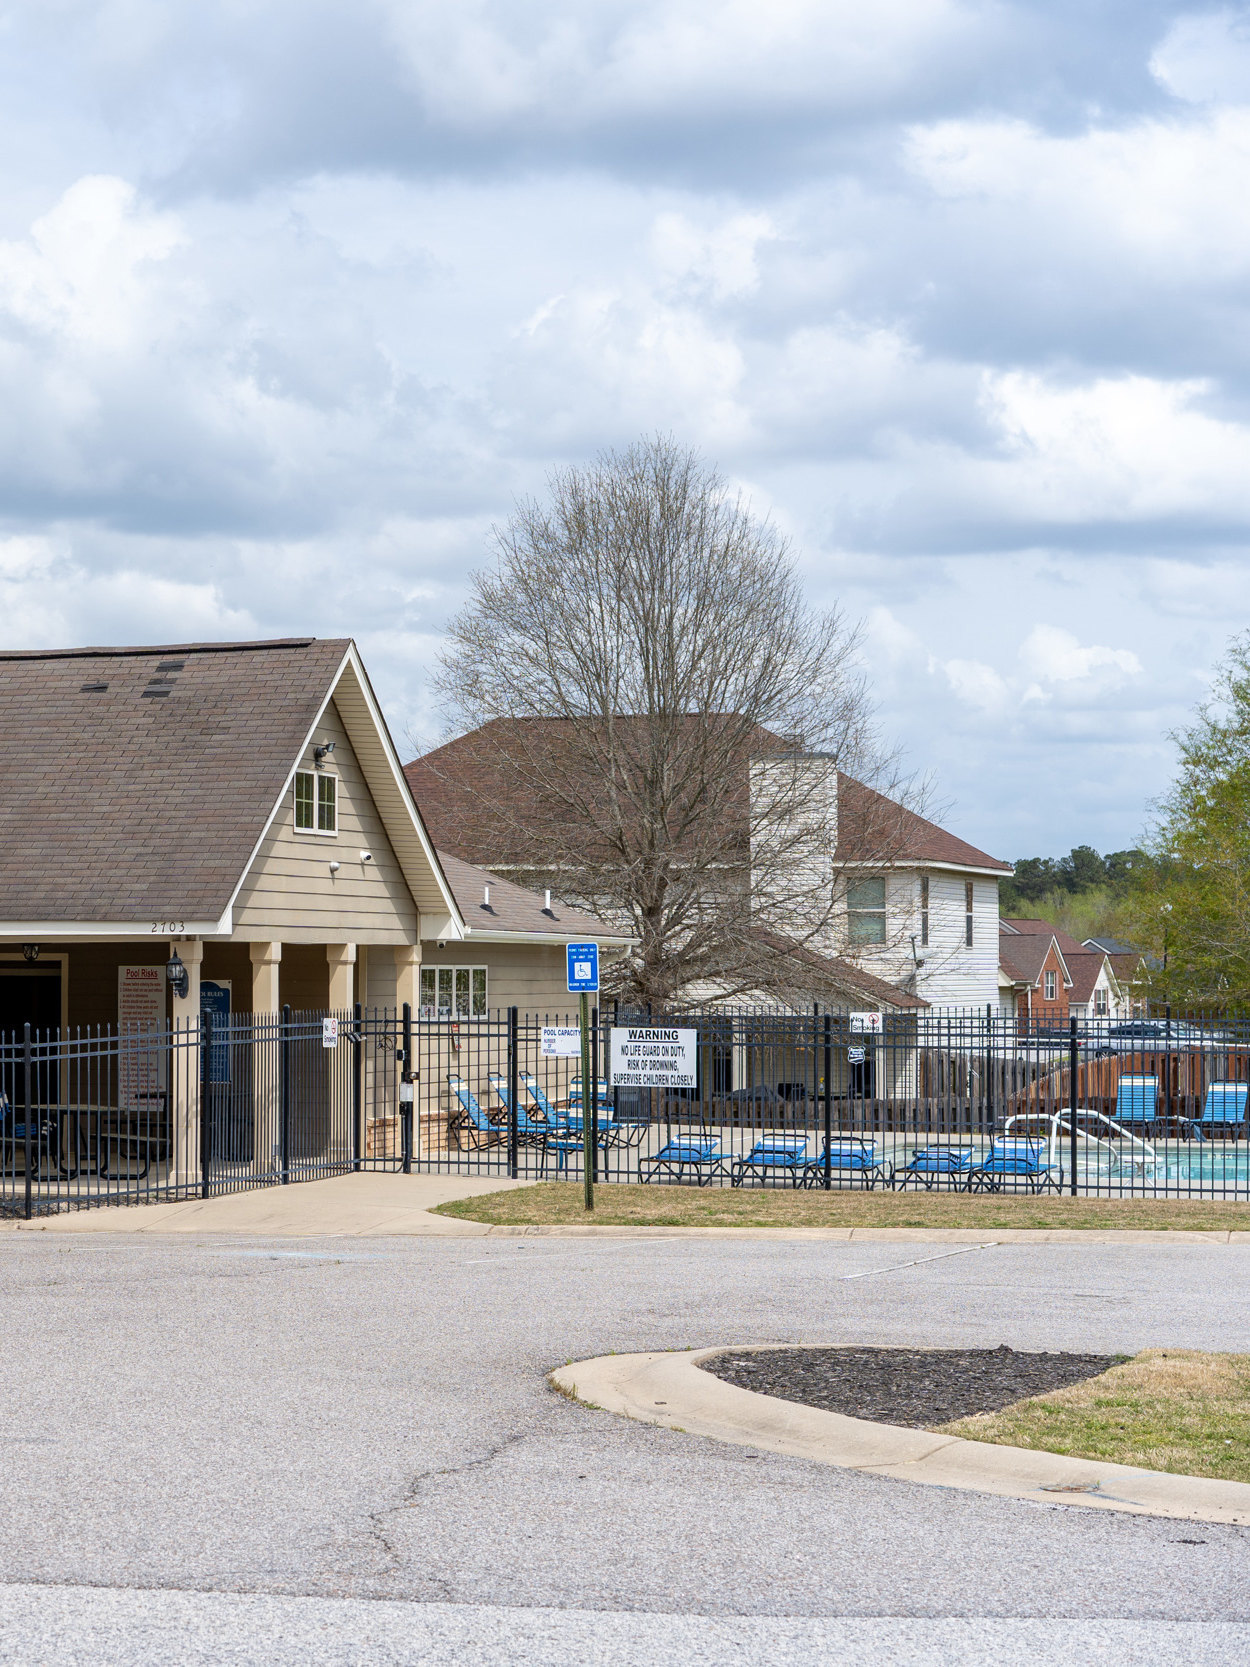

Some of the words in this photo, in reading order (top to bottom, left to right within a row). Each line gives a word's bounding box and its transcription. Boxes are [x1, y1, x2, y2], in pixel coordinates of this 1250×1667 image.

[152, 921, 184, 933] 2703
[126, 969, 139, 977] Pool
[141, 969, 158, 977] Risks
[324, 1035, 336, 1044] Smoking
[628, 1030, 678, 1040] WARNING
[621, 1045, 628, 1056] NO
[630, 1045, 641, 1056] LIFE
[642, 1046, 660, 1056] GUARD
[662, 1046, 669, 1056] ON
[671, 1046, 685, 1059] DUTY,
[628, 1060, 640, 1070] RISK
[641, 1060, 648, 1070] OF
[614, 1073, 642, 1084] SUPERVISE
[643, 1074, 669, 1085] CHILDREN
